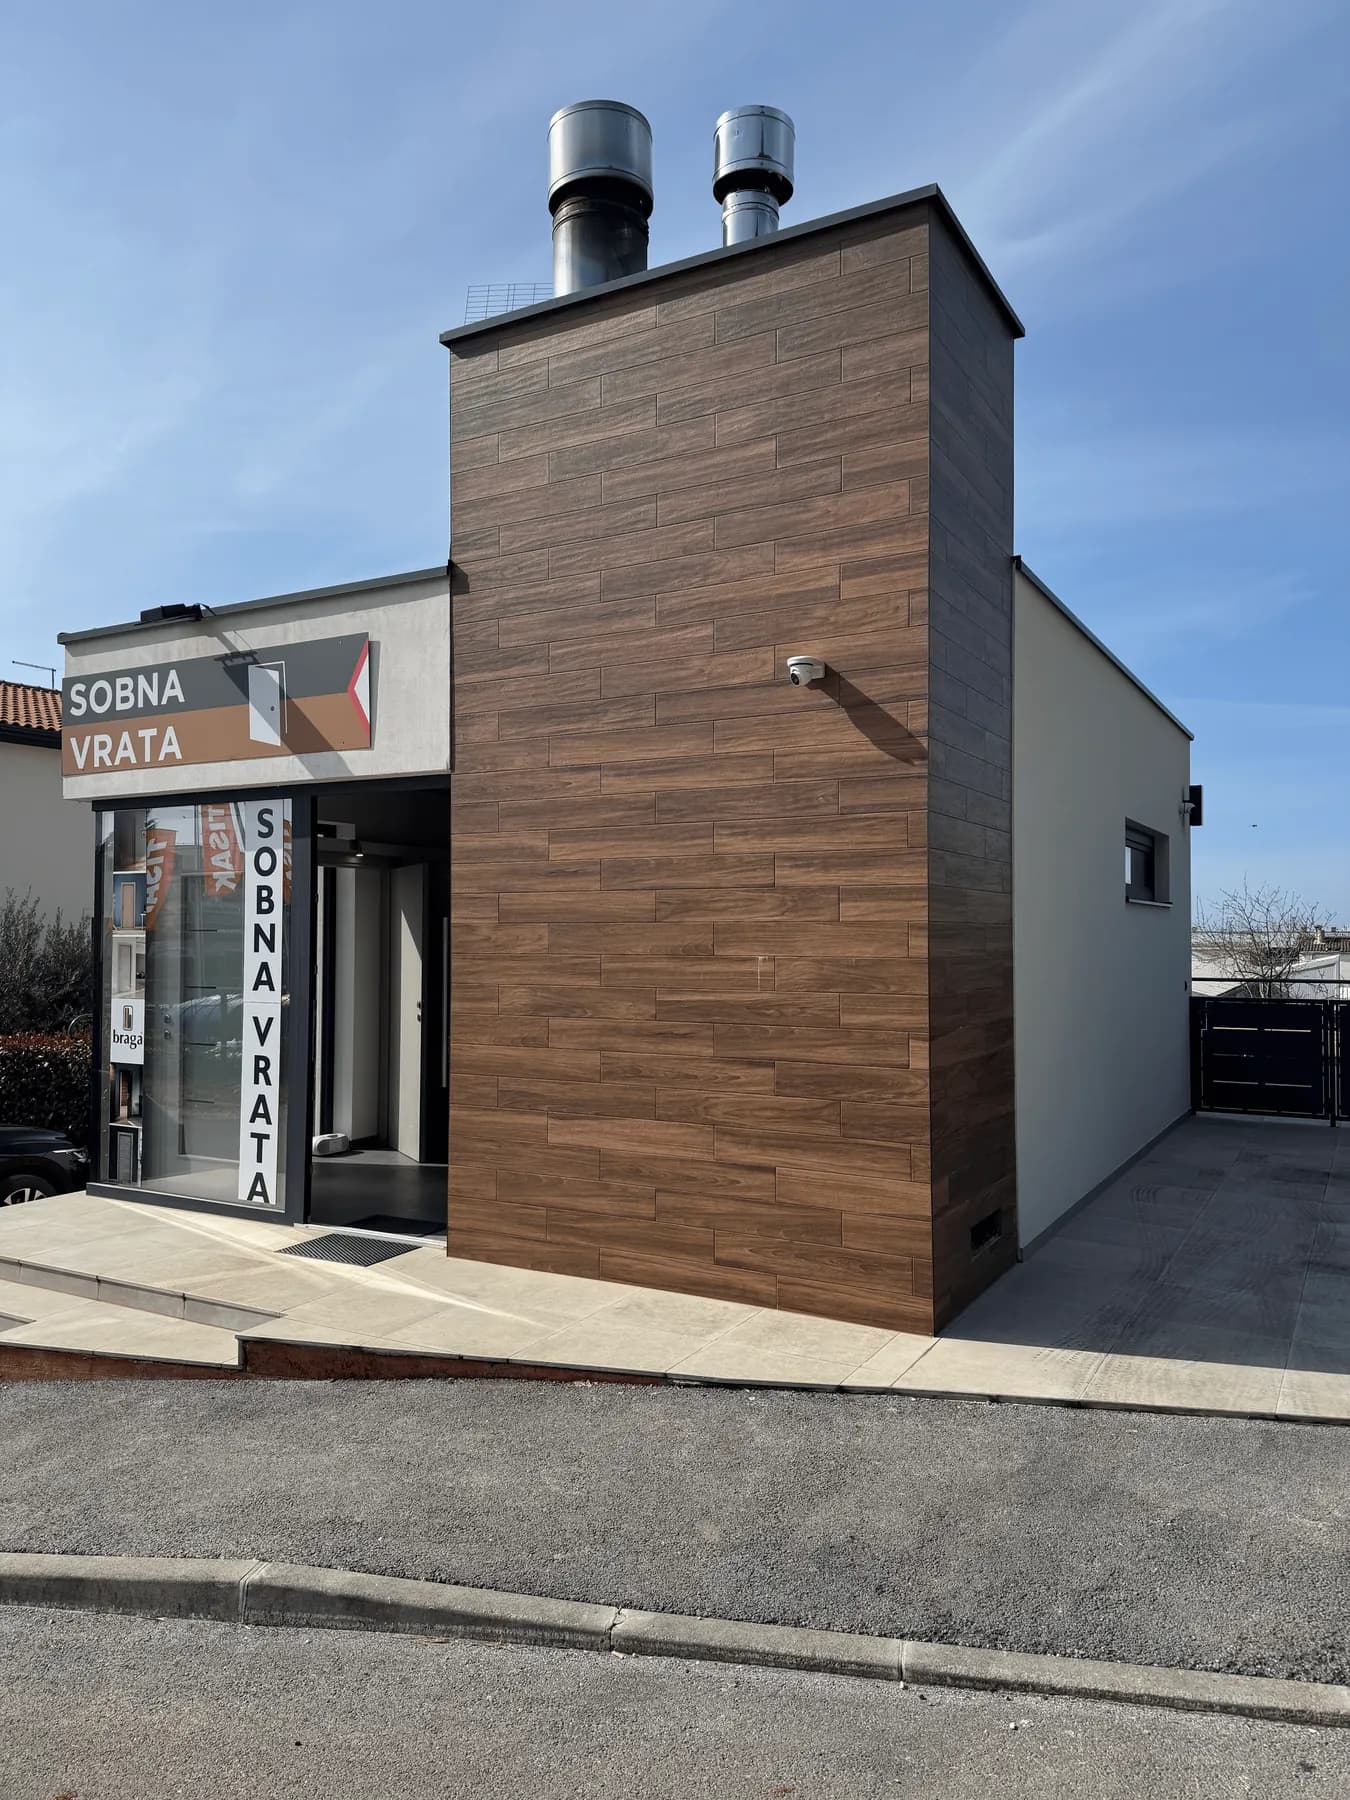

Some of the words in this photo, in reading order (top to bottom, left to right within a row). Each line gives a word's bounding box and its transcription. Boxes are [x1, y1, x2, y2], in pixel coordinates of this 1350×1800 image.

[69, 669, 185, 717] SOBNA
[70, 725, 183, 770] VRATA
[252, 808, 277, 992] SOBNA
[113, 1029, 143, 1049] braga
[246, 1016, 275, 1204] VRATA
